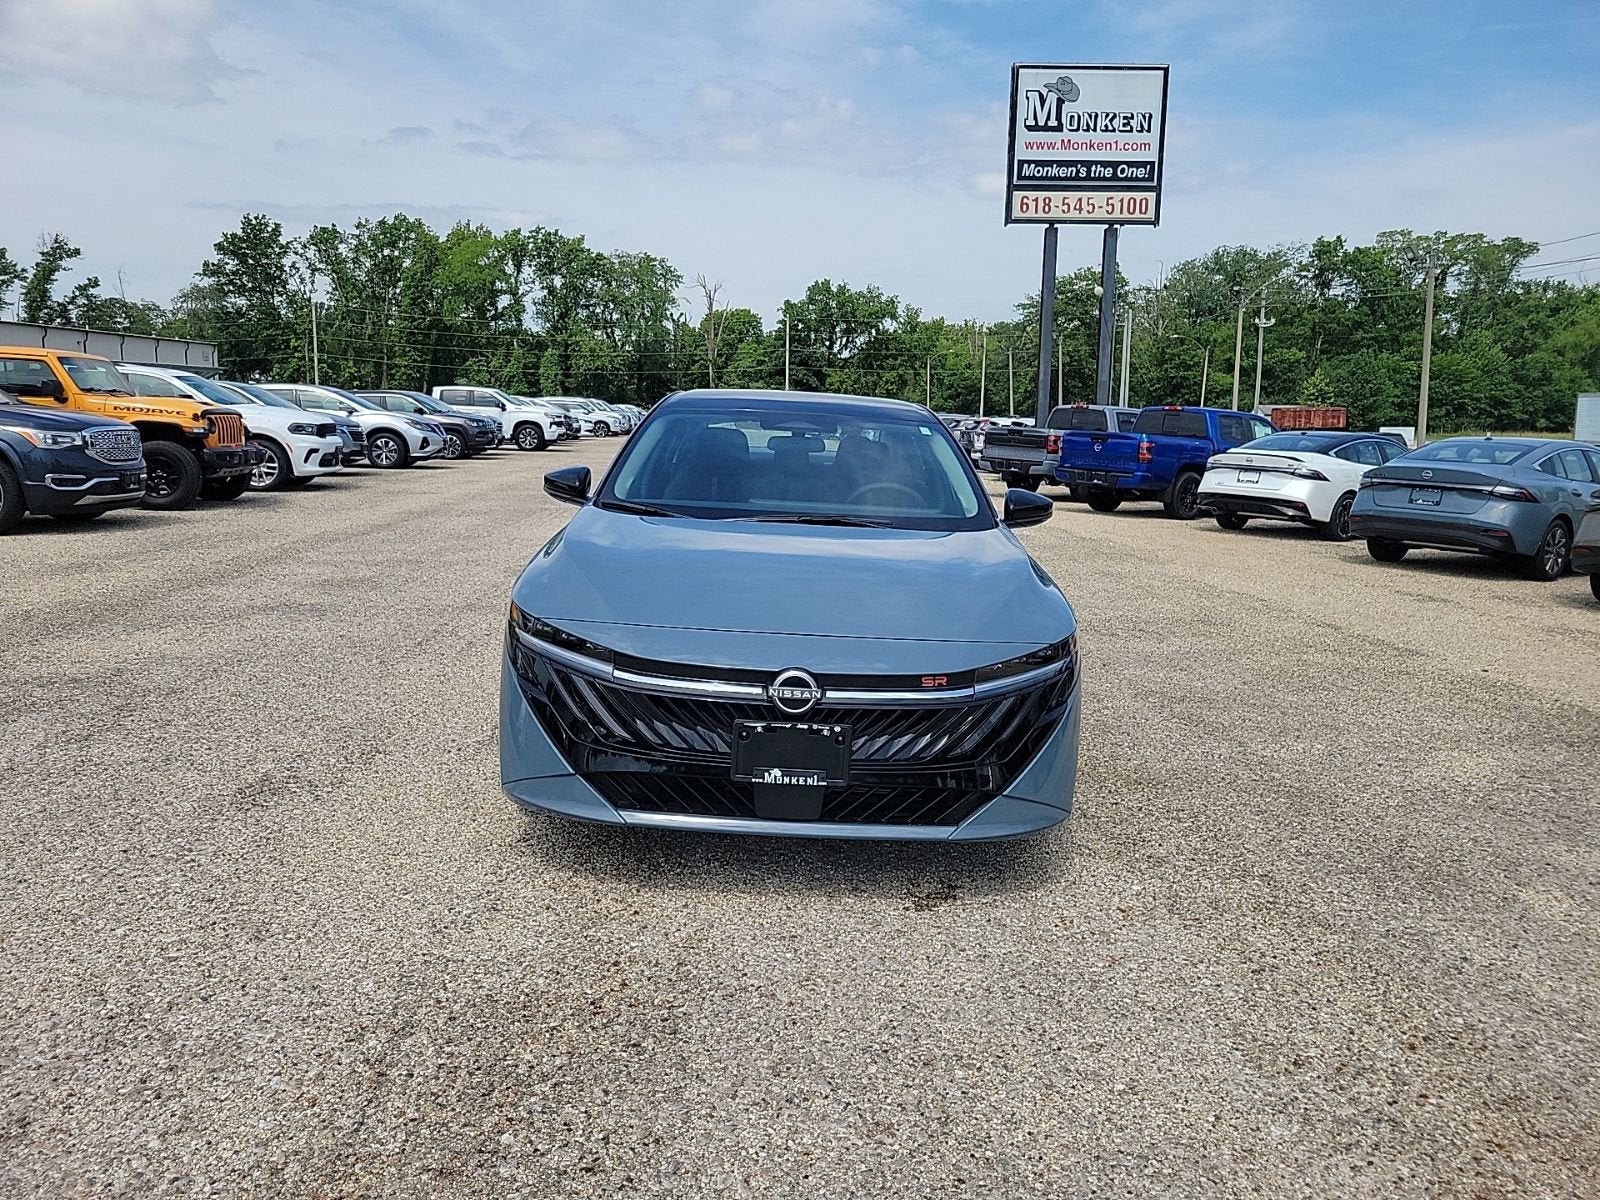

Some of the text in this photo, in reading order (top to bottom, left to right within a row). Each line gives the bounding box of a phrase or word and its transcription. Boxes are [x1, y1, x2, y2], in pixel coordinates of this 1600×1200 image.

[1024, 90, 1152, 133] MONKEN
[1024, 139, 1151, 151] www.Monken1.com
[1021, 163, 1150, 178] Monken's the One!
[1019, 196, 1149, 215] 618-545-5100
[921, 676, 947, 687] SR
[769, 689, 821, 698] NISSAN
